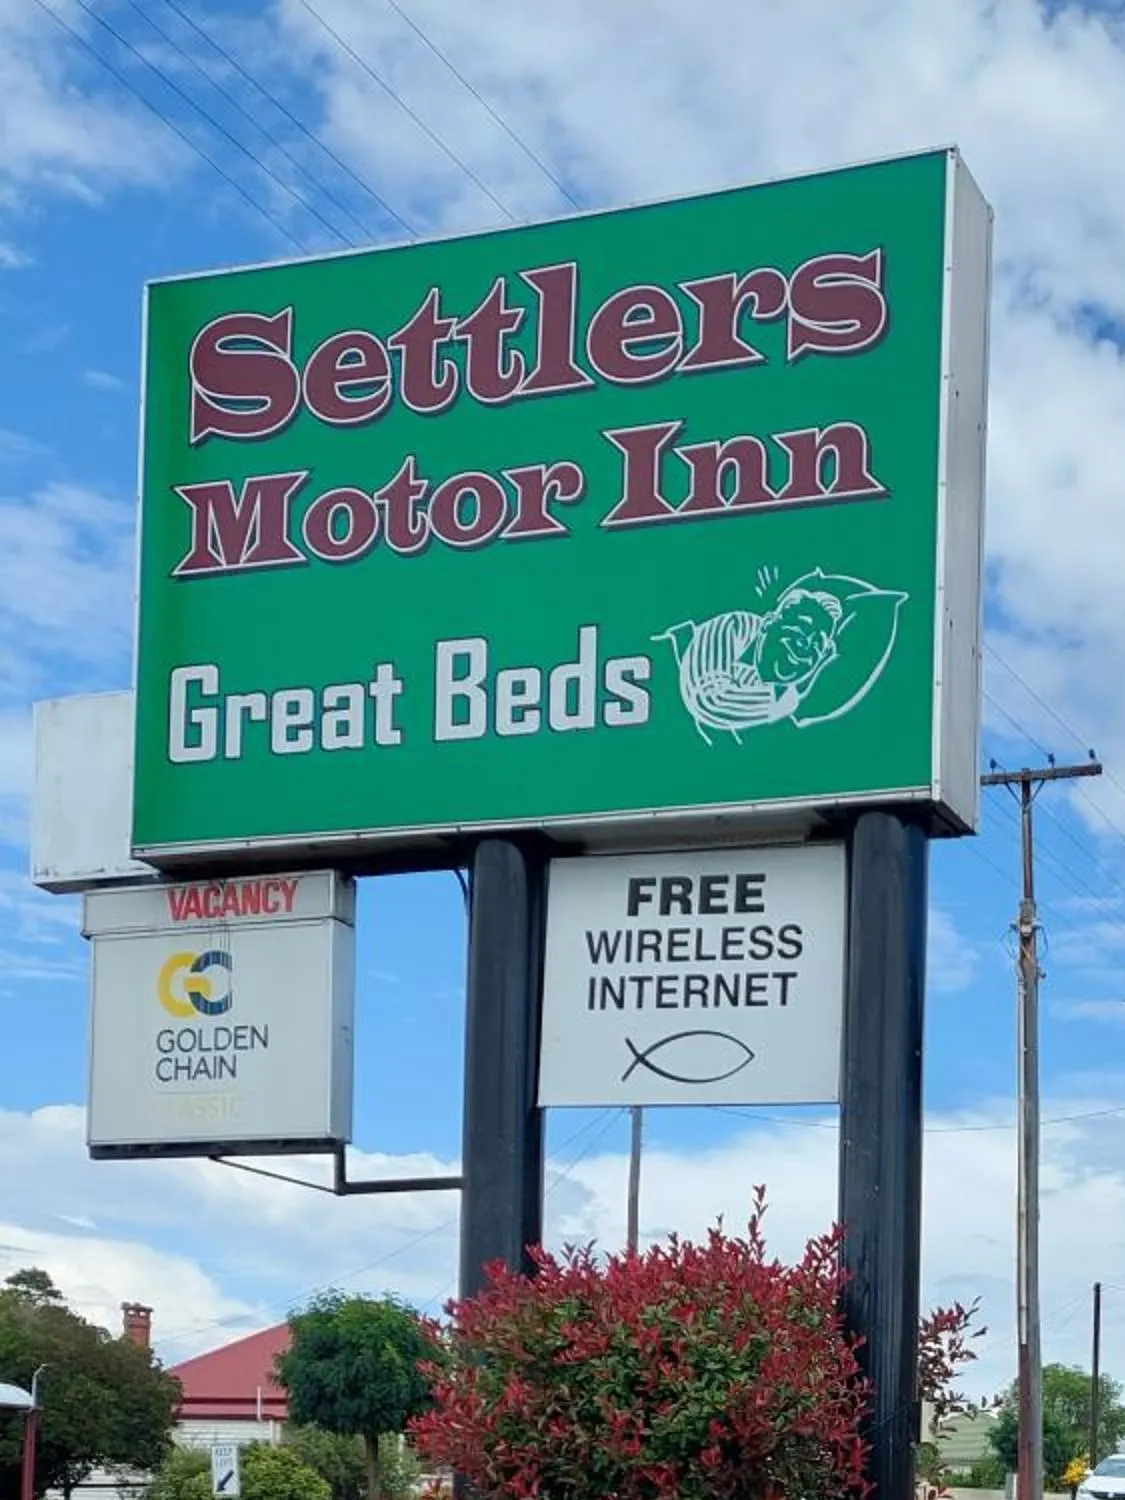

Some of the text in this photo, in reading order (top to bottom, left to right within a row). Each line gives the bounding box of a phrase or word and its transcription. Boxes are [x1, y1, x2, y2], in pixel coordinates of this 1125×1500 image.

[189, 249, 890, 444] Settlers
[173, 419, 892, 578] Motor Inn
[168, 624, 653, 764] Great Beds
[168, 878, 298, 921] VACANCY
[627, 873, 766, 916] FREE
[585, 924, 803, 964] WIRELESS
[587, 972, 798, 1010] INTERNET
[156, 1024, 269, 1053] GOLDEN
[155, 1054, 237, 1082] CHAIN
